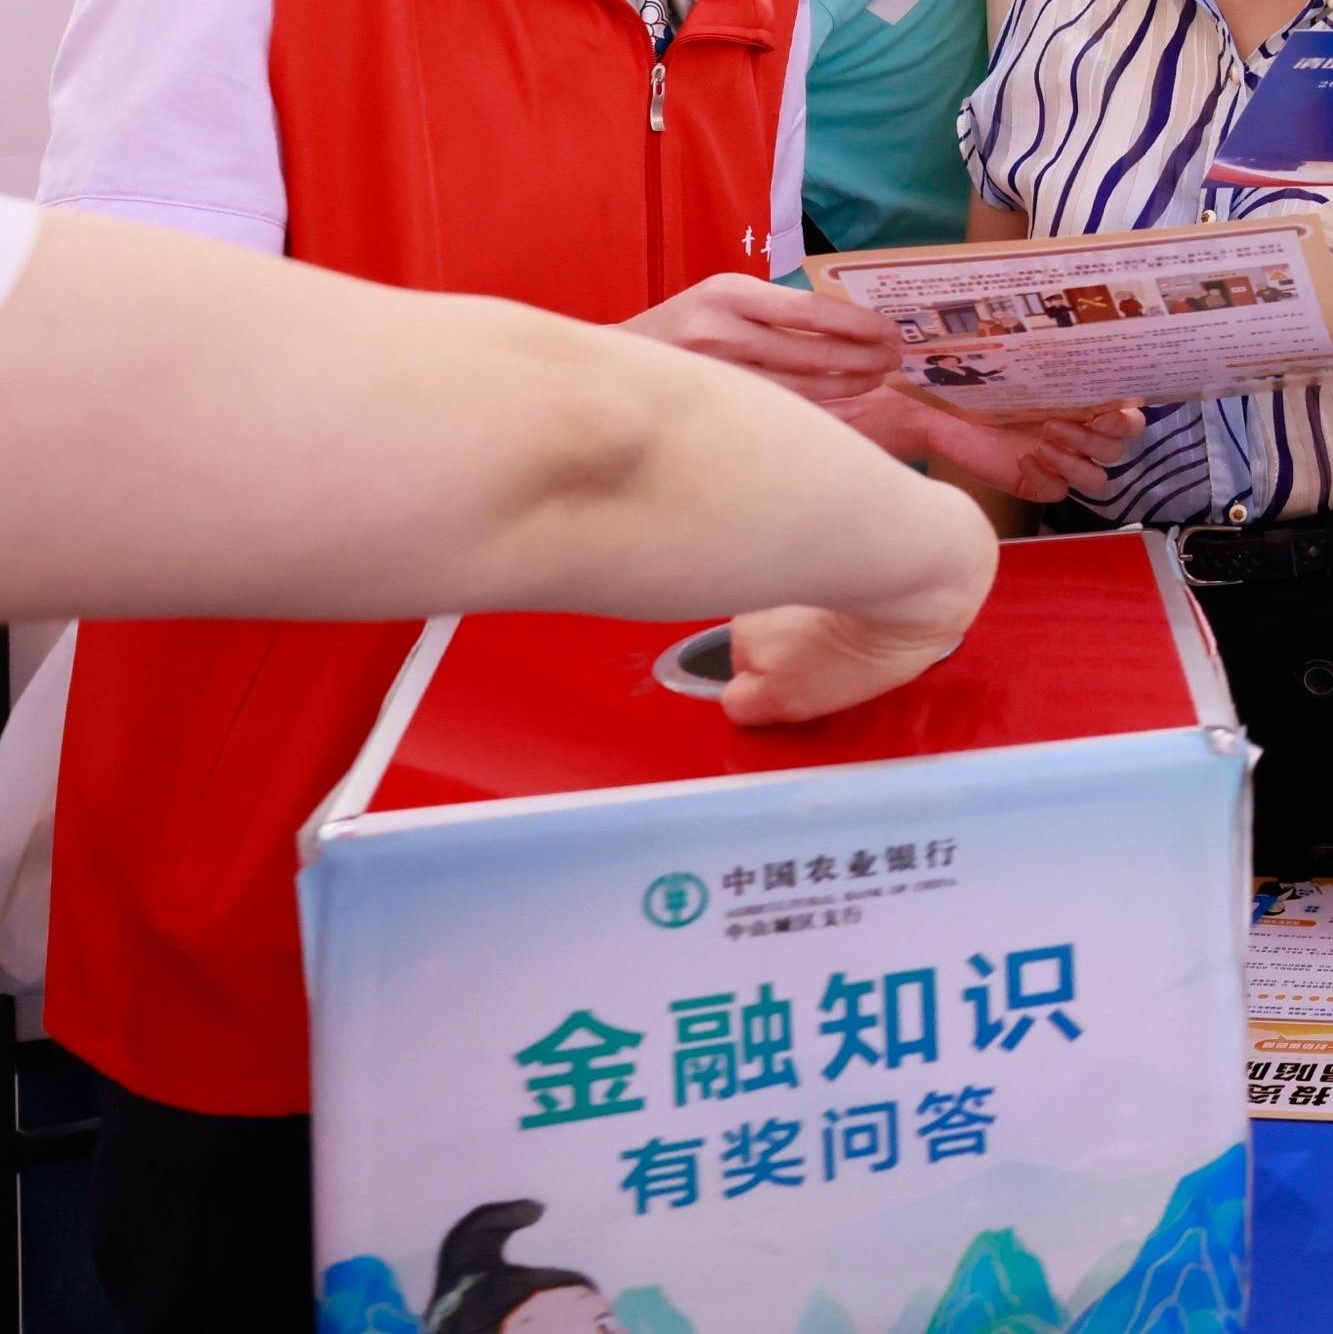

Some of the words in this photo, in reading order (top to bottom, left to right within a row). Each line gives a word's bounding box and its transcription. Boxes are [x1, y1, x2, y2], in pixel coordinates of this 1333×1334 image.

[721, 836, 959, 897] 中国农业银行
[514, 943, 1085, 1133] 金融知识
[618, 1083, 999, 1216] 有奖问答
